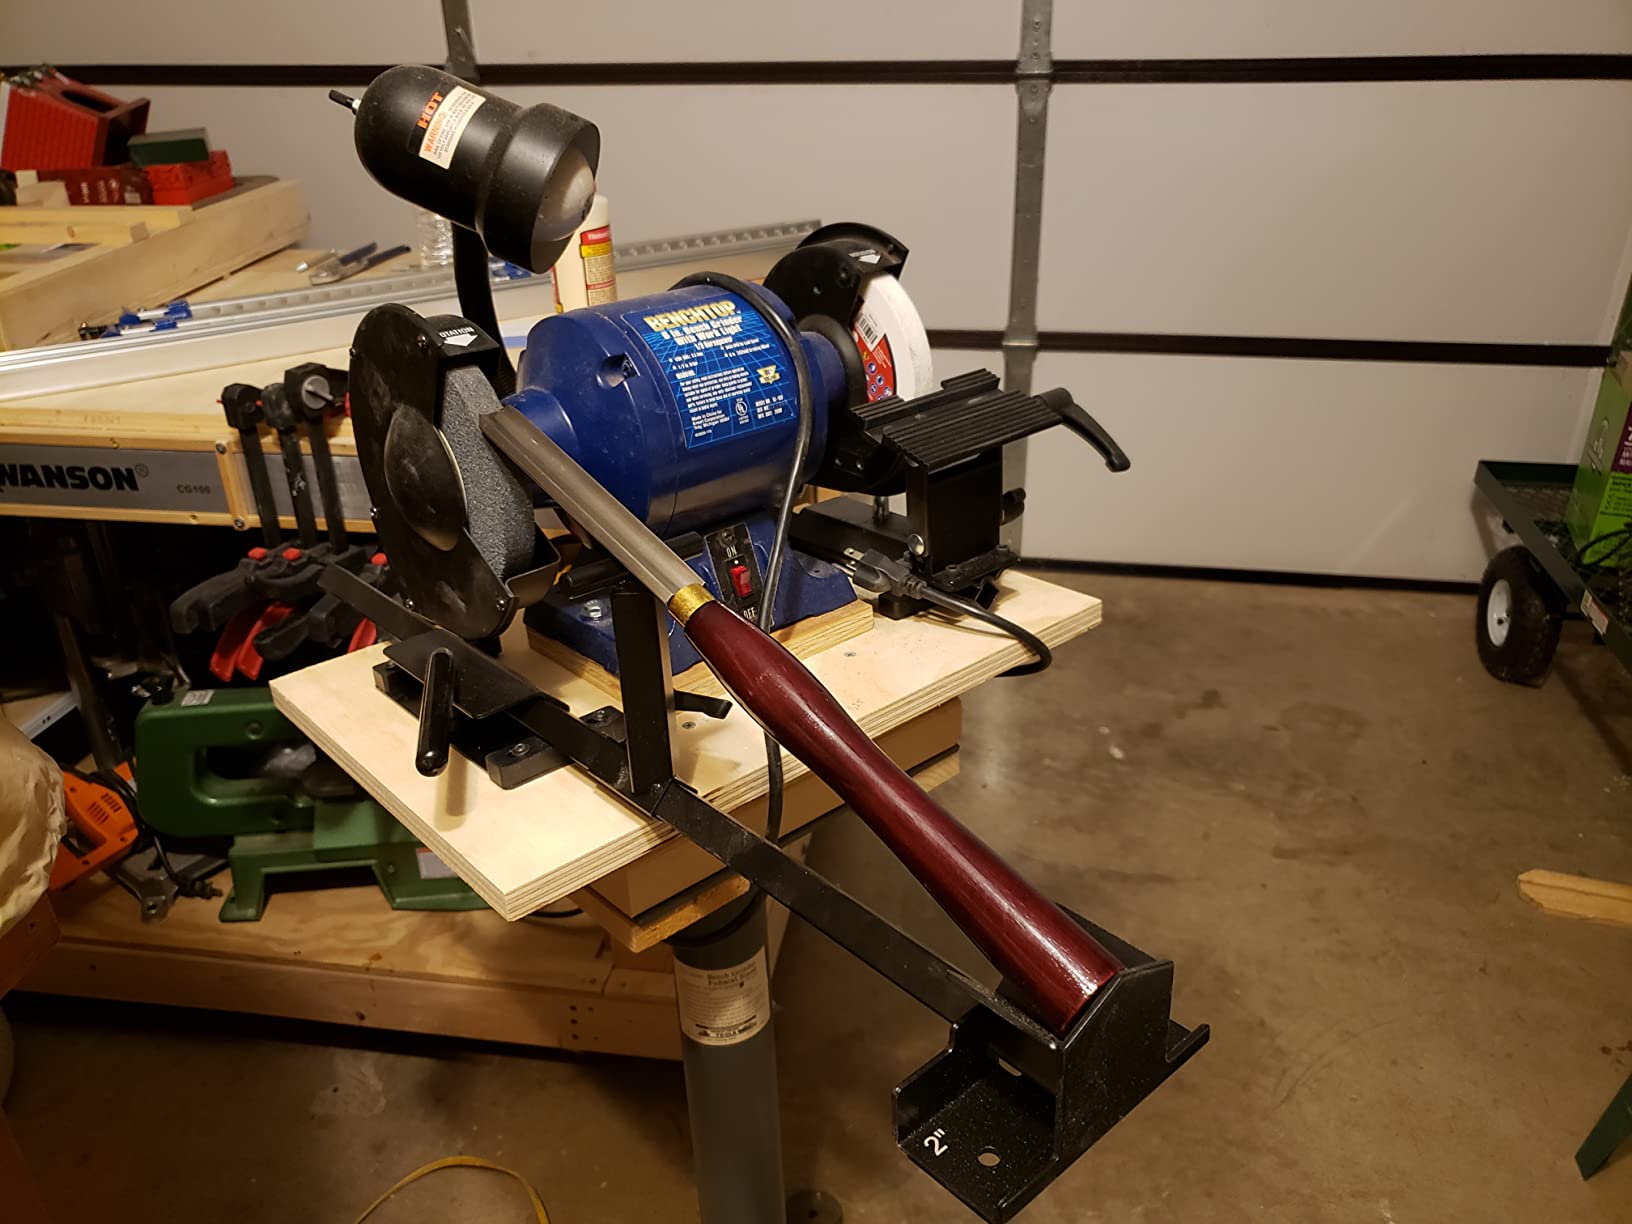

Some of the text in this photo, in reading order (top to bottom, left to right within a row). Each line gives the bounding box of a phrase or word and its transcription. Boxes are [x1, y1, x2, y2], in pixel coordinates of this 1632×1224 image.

[416, 91, 443, 129] HOT
[643, 300, 735, 332] BENCHTOP
[683, 323, 710, 334] Bench
[710, 316, 742, 328] Grinder
[696, 329, 721, 340] Work
[720, 324, 742, 335] Light
[726, 545, 737, 558] ON
[743, 606, 756, 619] OFF
[924, 1128, 948, 1156] 2"
